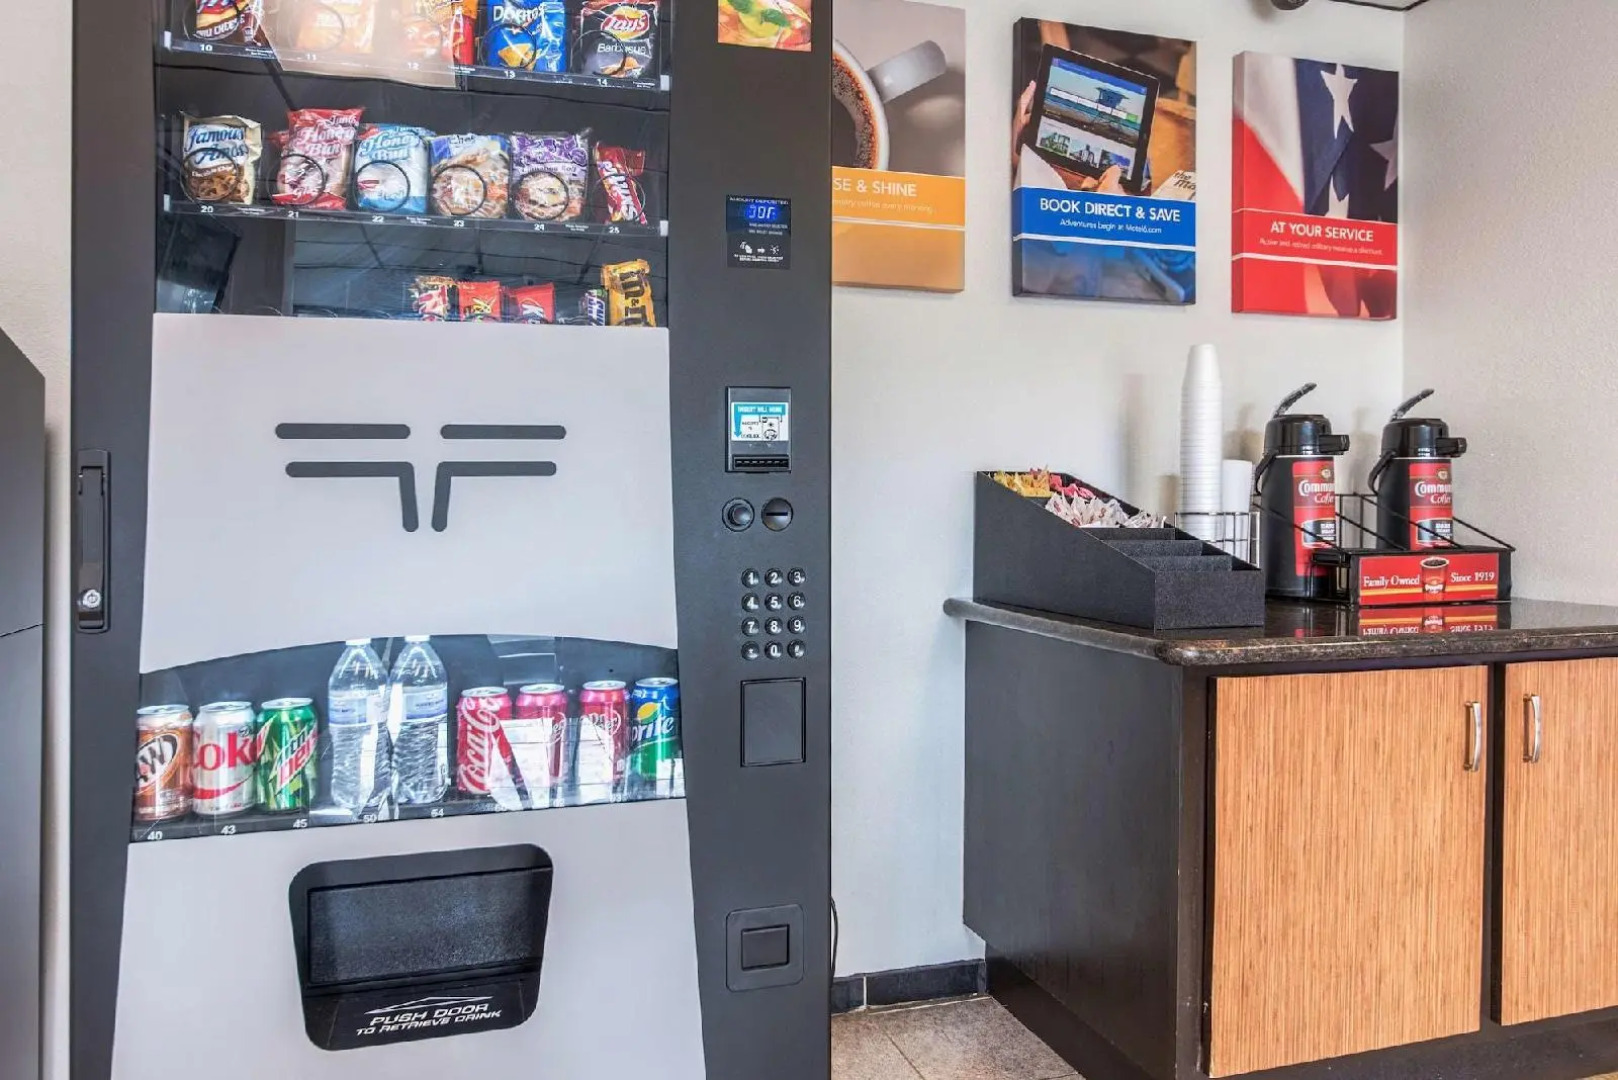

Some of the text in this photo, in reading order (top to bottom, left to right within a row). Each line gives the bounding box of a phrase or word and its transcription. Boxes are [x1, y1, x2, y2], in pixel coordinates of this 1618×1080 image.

[200, 44, 213, 52] 10
[407, 62, 420, 70] 12
[504, 70, 516, 79] 13
[597, 78, 608, 87] 14
[856, 180, 867, 193] &
[872, 181, 917, 197] SHINE
[200, 205, 214, 213] 20
[287, 210, 299, 218] 21
[1040, 198, 1181, 222] BOOK DIRECT & SAVE
[1271, 221, 1374, 242] AT YOUR SERVICE
[748, 571, 801, 584] 1 2 3
[1363, 571, 1495, 589] Family Owned Since 1919
[747, 595, 801, 609] 4 5 6
[747, 619, 801, 633] 7 8 9
[770, 644, 778, 656] 0
[221, 824, 237, 835] 43
[293, 818, 308, 829] 45
[147, 830, 163, 840] 40
[369, 1003, 489, 1026] PUSH DOOR
[356, 1009, 502, 1036] TO RETRIEVE DRINK
